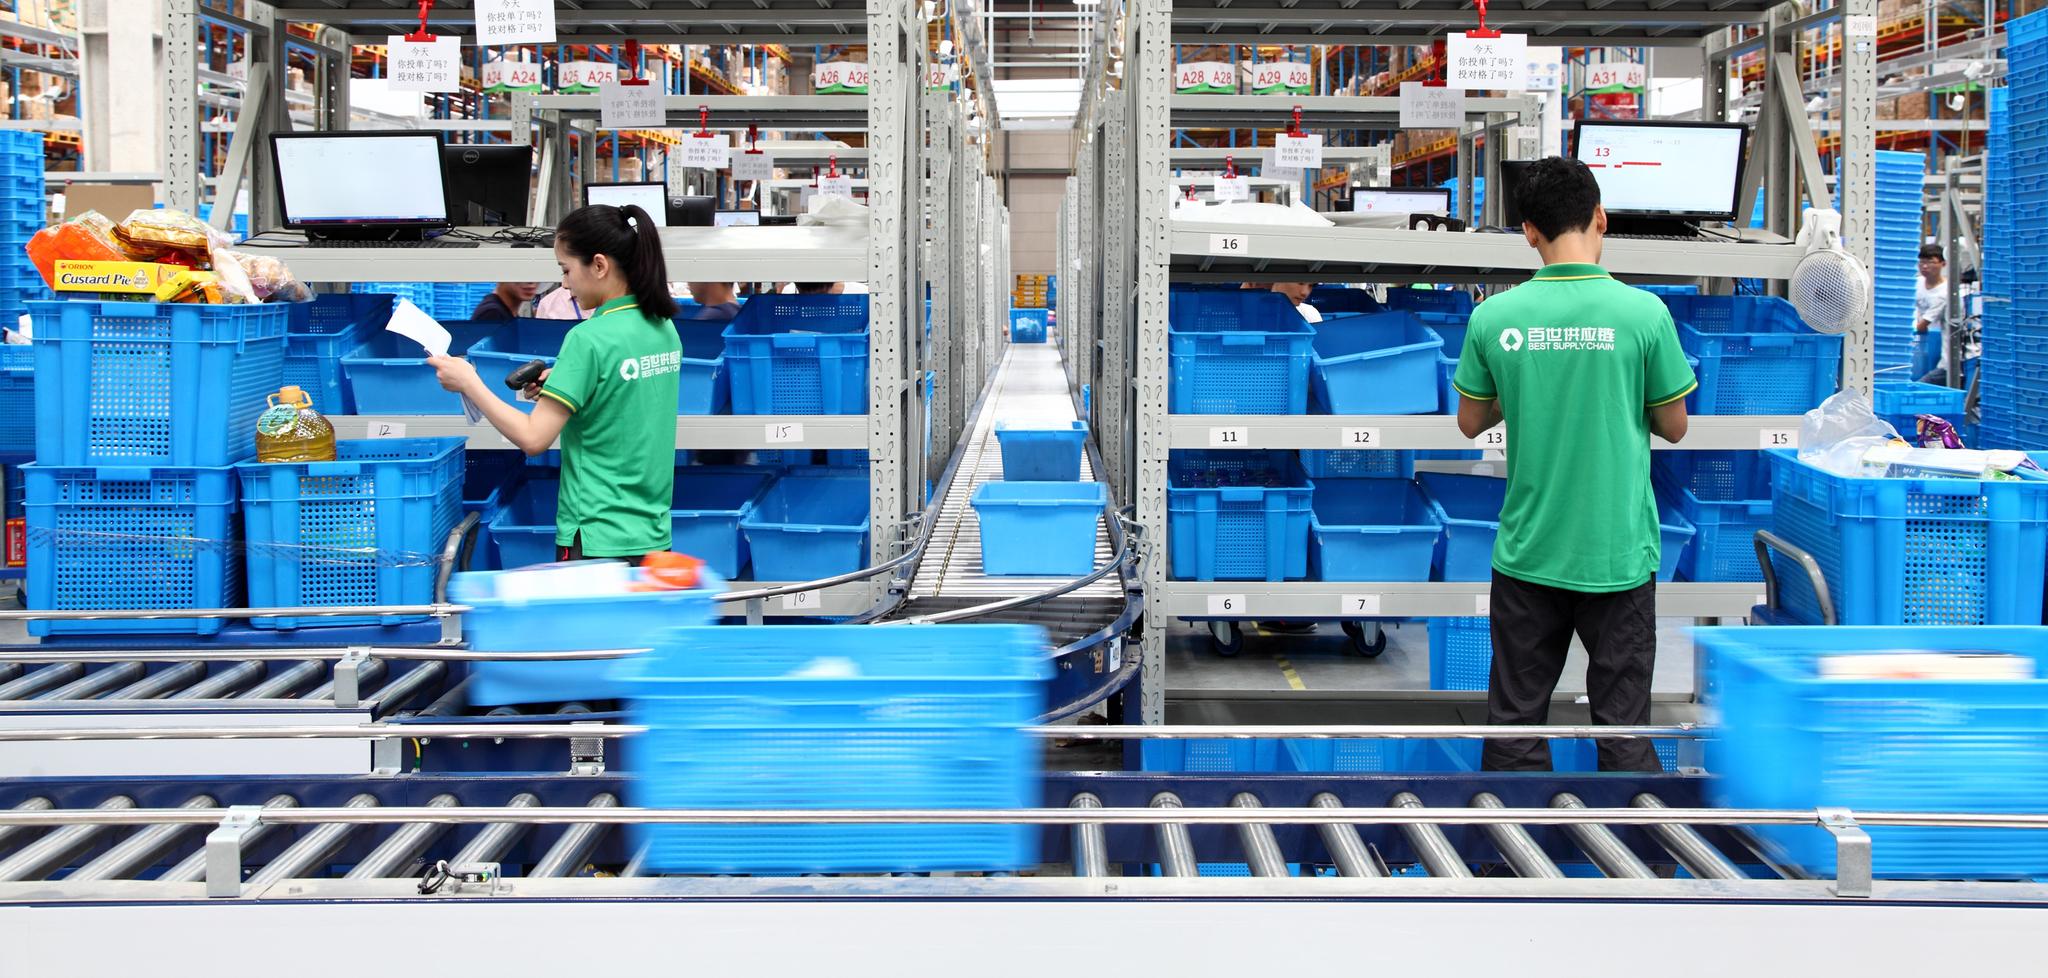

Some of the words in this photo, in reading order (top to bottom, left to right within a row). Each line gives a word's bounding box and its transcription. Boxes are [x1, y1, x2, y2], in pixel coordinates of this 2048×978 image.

[411, 47, 429, 57] 今天
[1473, 44, 1493, 54] 今天
[511, 70, 536, 83] A24
[562, 70, 579, 83] A25
[588, 70, 612, 83] A25
[821, 70, 839, 84] A26
[848, 71, 868, 84] A26
[1182, 70, 1205, 84] A28
[1213, 71, 1232, 84] A28
[1258, 71, 1281, 84] A29
[1289, 71, 1307, 84] A29
[1591, 72, 1617, 84] A31
[1627, 72, 1641, 84] A31
[1595, 148, 1610, 157] 13
[1222, 239, 1238, 249] 16
[61, 273, 110, 285] Custard
[113, 274, 132, 286] Pie
[1528, 327, 1615, 342] 百世供应链
[1528, 342, 1551, 350] BEST
[1553, 342, 1585, 350] SUPPLY
[1586, 342, 1614, 351] CHAIN
[641, 369, 655, 378] BEST
[379, 424, 391, 436] 12
[776, 425, 791, 438] 15
[1222, 432, 1237, 441] 11
[1354, 432, 1370, 442] 12
[1487, 433, 1502, 443] 13
[1772, 433, 1788, 444] 15
[794, 592, 806, 606] 10
[1224, 599, 1232, 610] 6
[1358, 599, 1366, 610] 7
